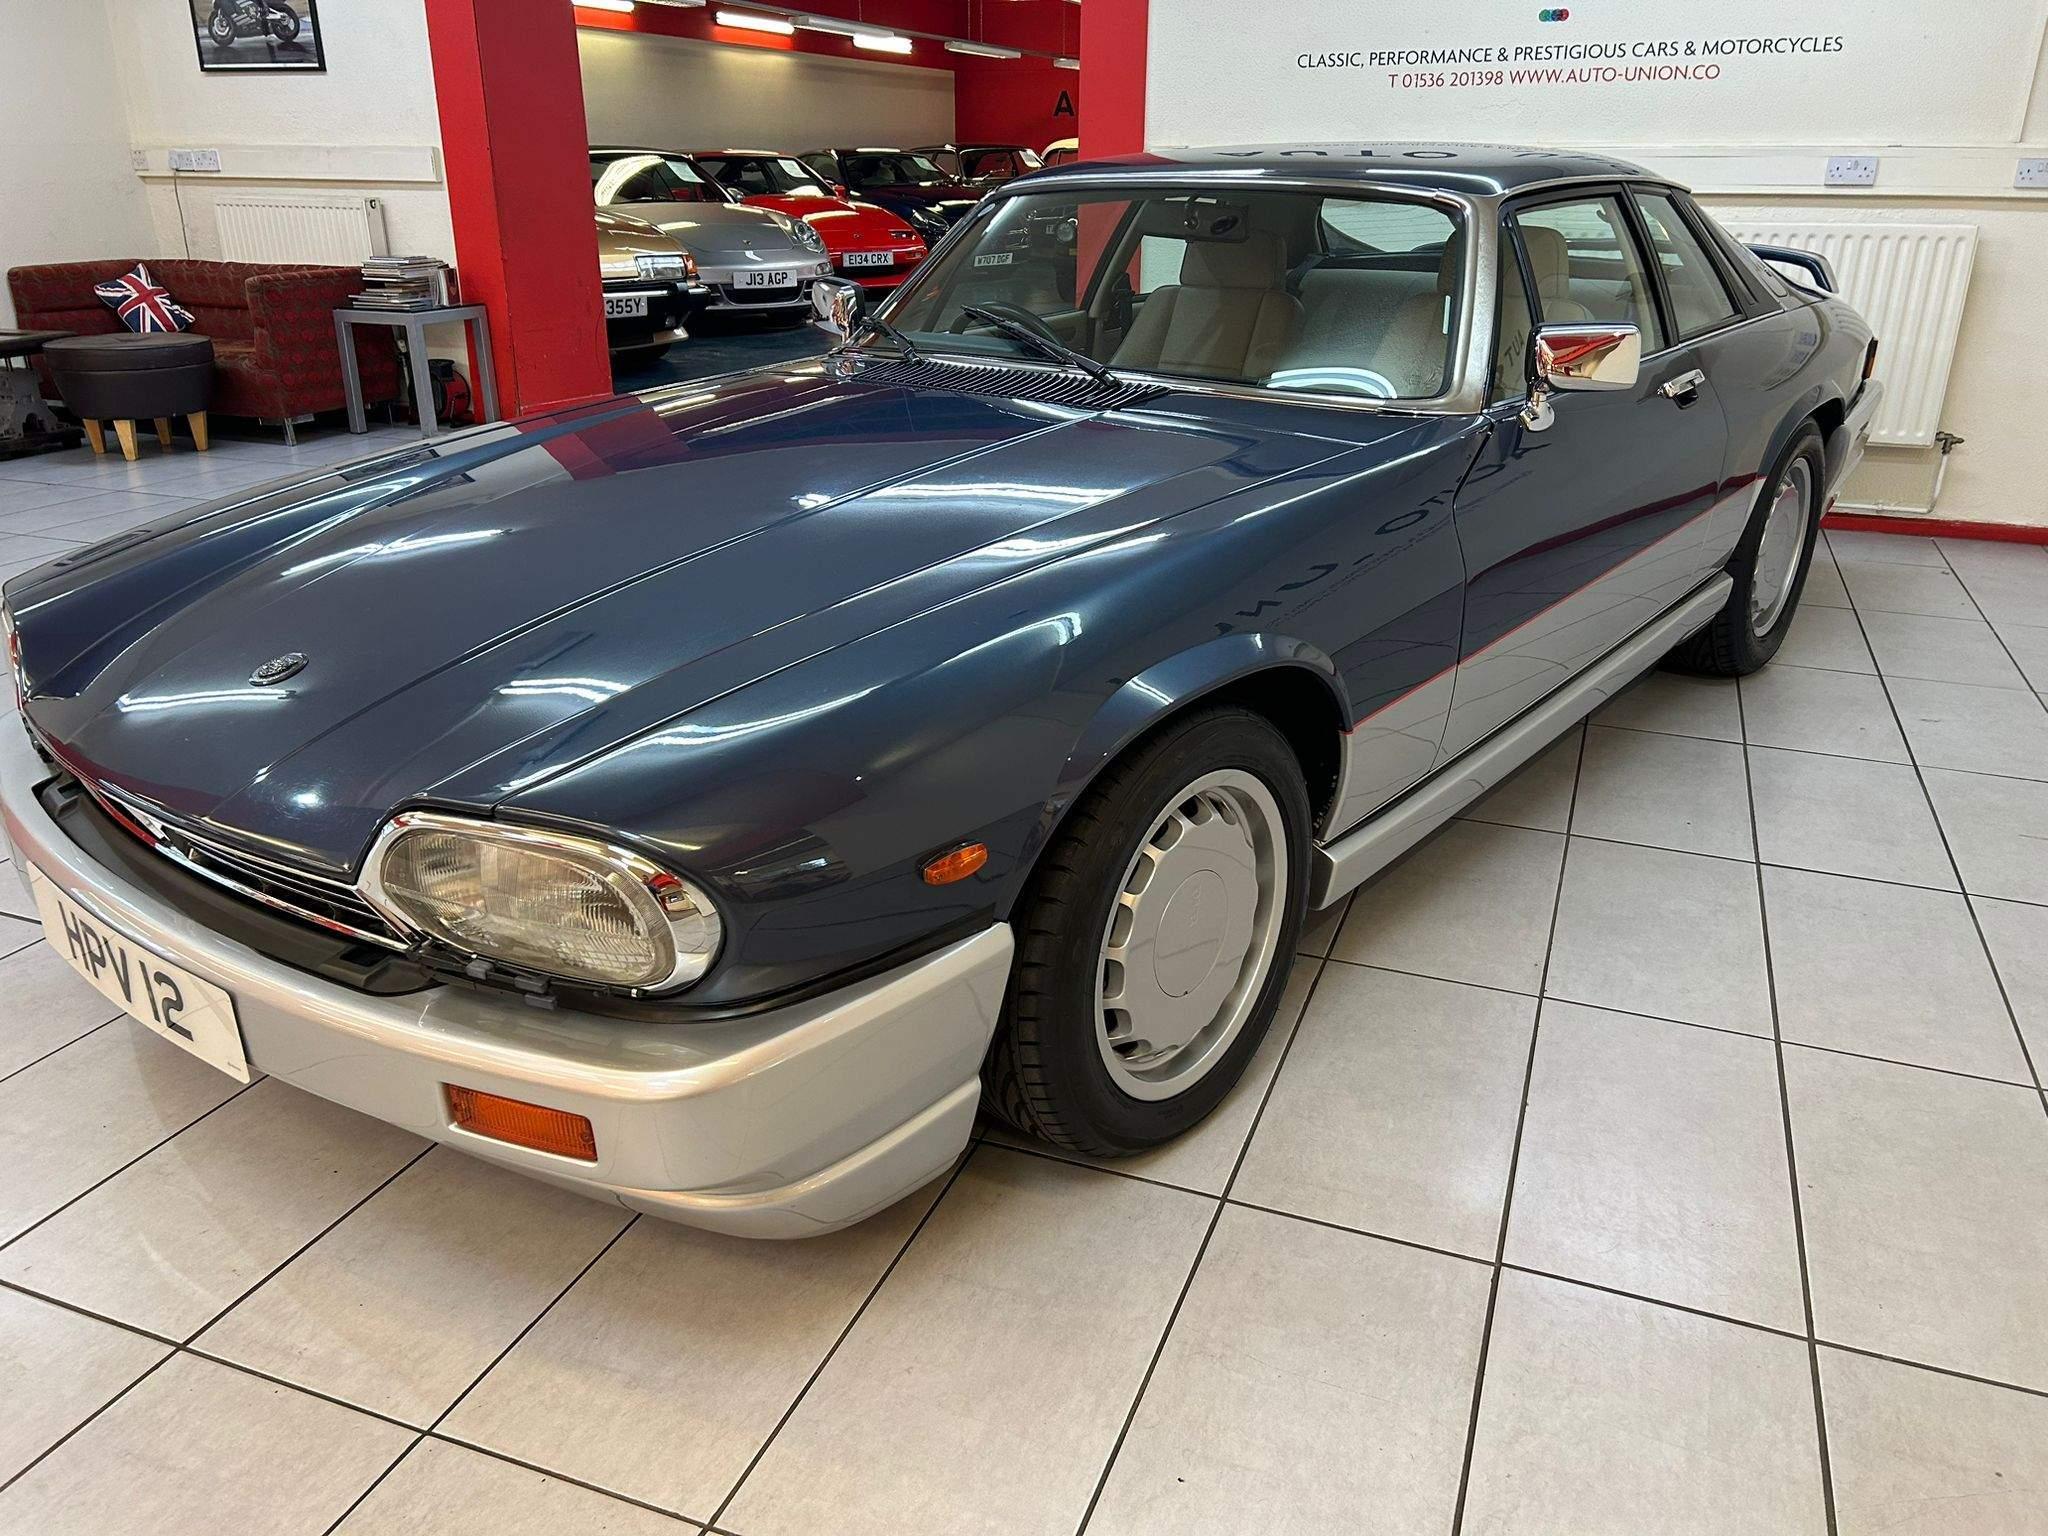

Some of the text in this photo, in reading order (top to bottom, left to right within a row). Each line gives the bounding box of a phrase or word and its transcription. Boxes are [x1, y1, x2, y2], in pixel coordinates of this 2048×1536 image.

[1297, 36, 1843, 69] CLASSIC, PERFORMANCE & PRESTIGIOUS CARS & MOTORCYCLES
[1388, 64, 1721, 88] T 01536 201398 WWW.AUTO-UNION.CO
[1053, 90, 1075, 117] A
[848, 253, 889, 265] E134 CRX
[745, 271, 788, 286] J13 AGP
[606, 297, 642, 315] 355Y
[57, 900, 195, 1042] HPV 12
